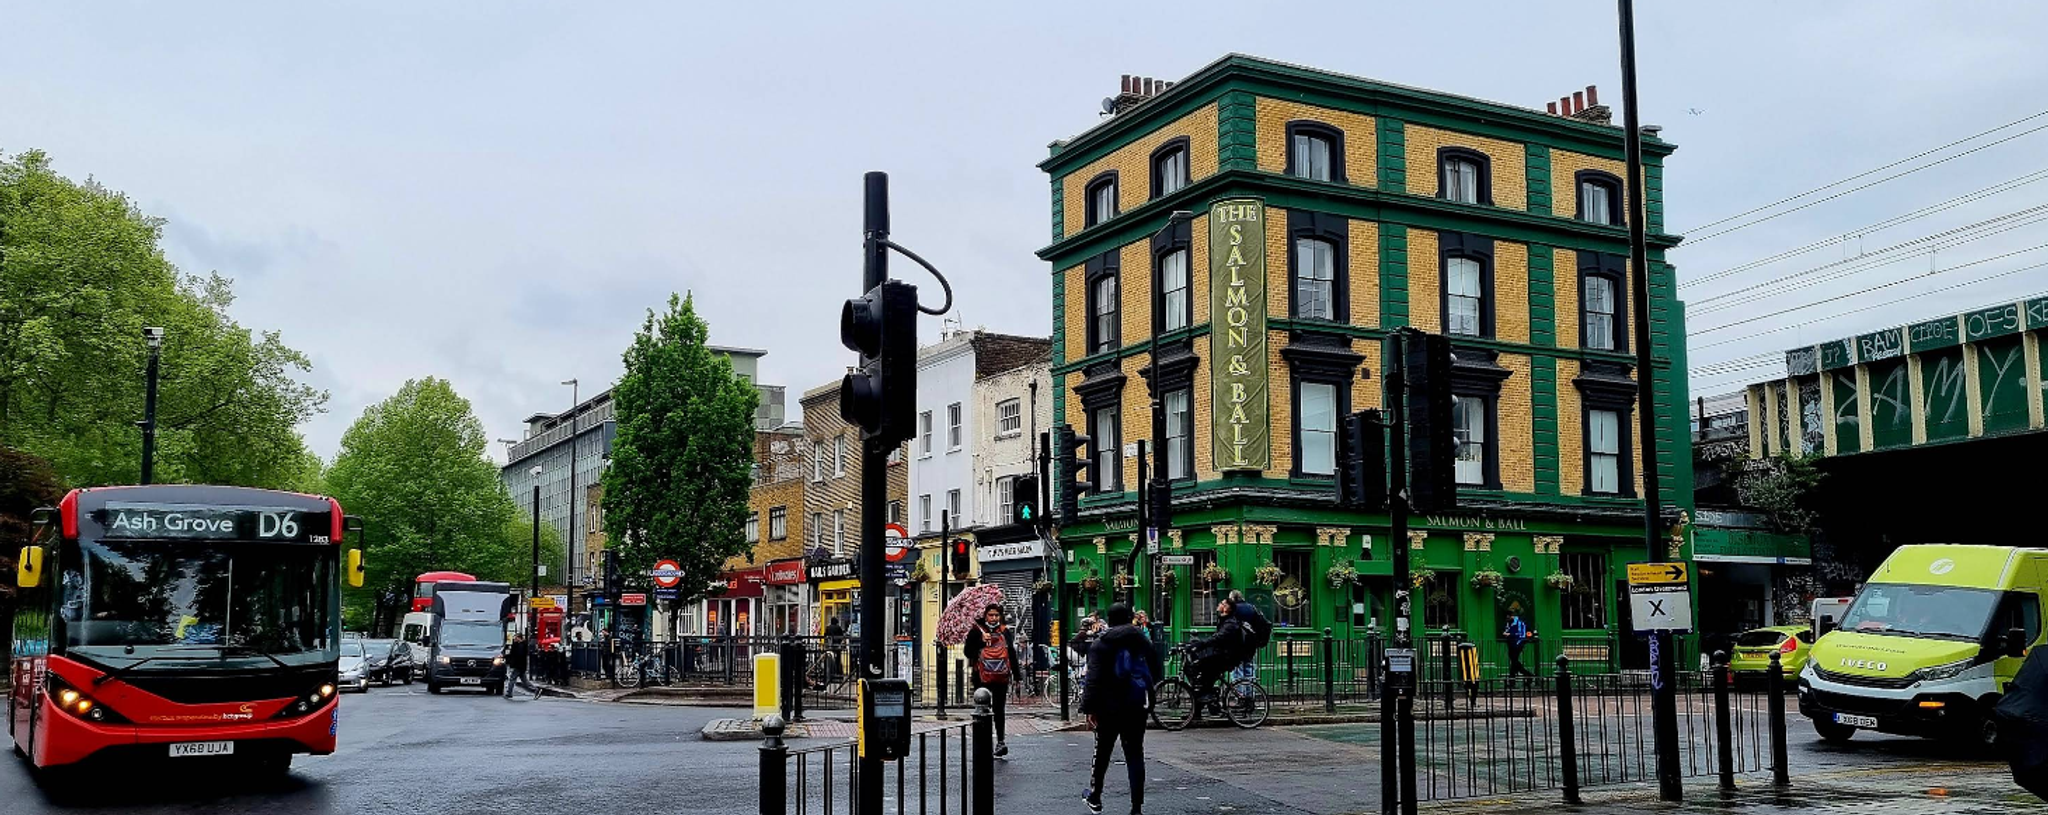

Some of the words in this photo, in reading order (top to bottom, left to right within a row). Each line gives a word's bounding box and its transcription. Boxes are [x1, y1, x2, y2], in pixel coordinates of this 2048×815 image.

[1218, 204, 1257, 222] THE
[1225, 224, 1250, 348] SALMON
[1228, 355, 1251, 376] &
[1228, 382, 1250, 466] BALL
[112, 512, 156, 530] Ash
[164, 513, 233, 532] Grove
[259, 511, 298, 537] D6
[1426, 515, 1480, 527] SALMON
[1485, 519, 1495, 528] &
[1498, 518, 1526, 530] BALL
[1648, 599, 1666, 617] X
[1841, 658, 1888, 672] IVECO
[175, 743, 204, 754] YX68
[207, 742, 229, 753] UJA
